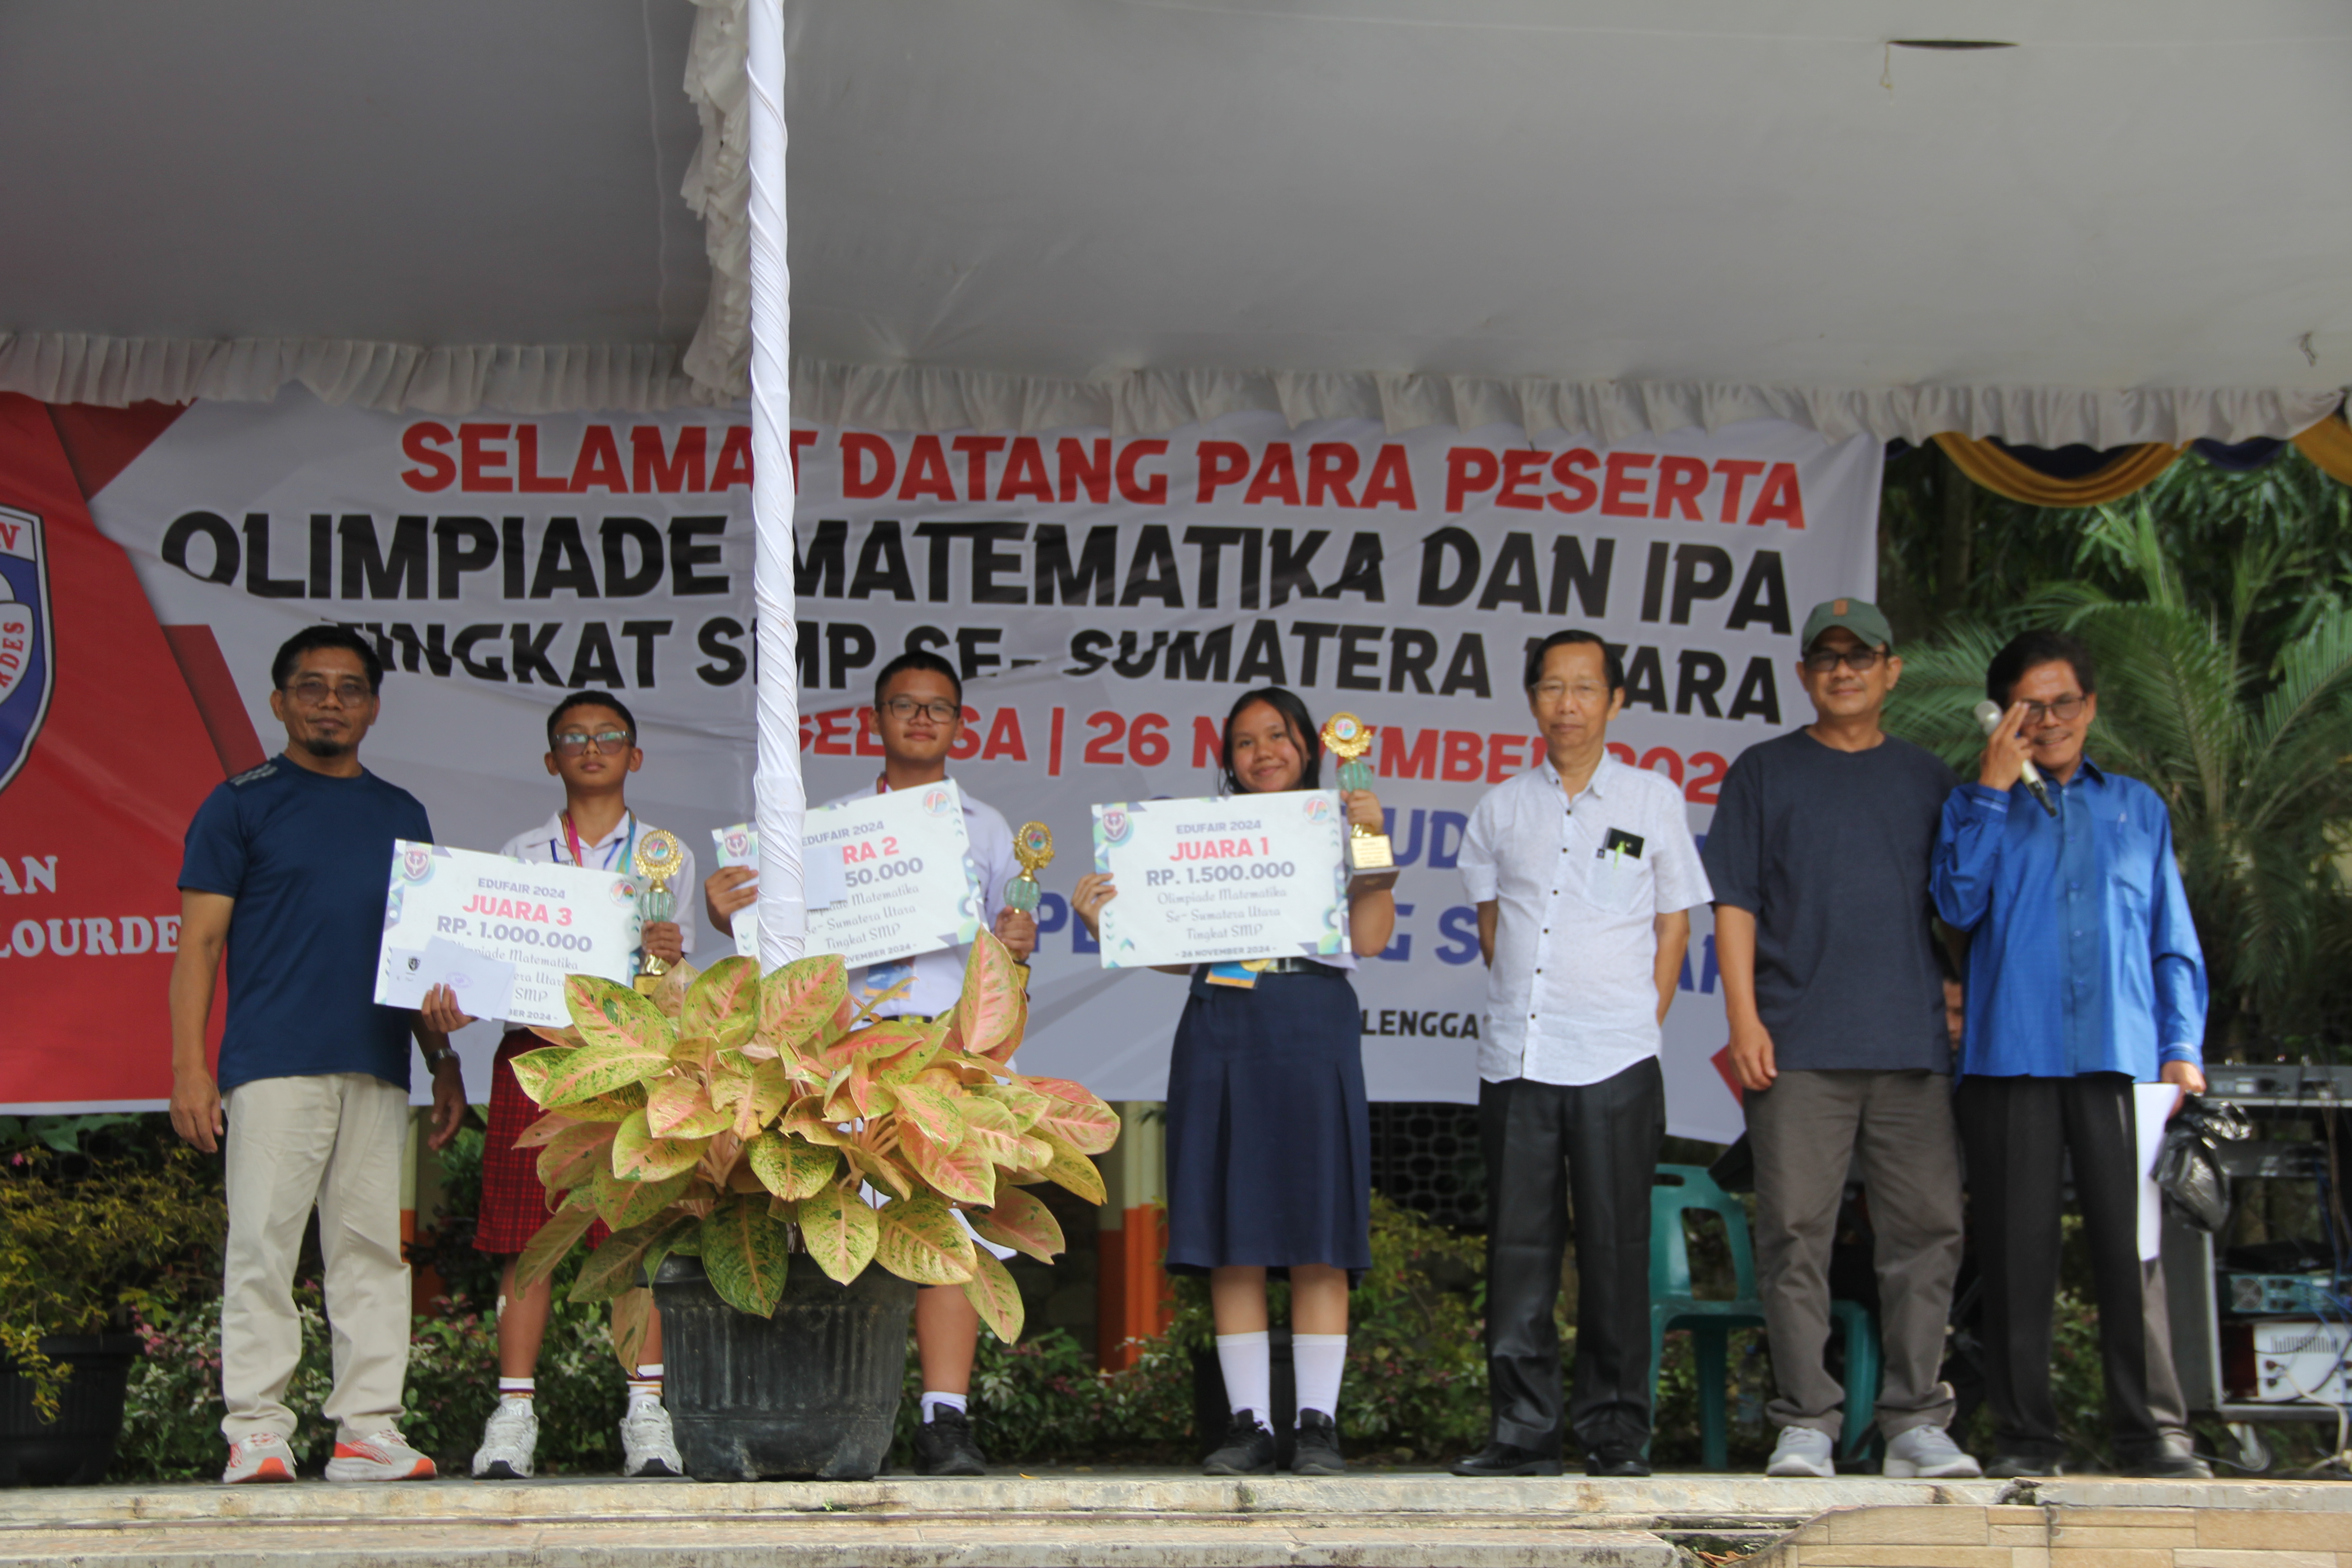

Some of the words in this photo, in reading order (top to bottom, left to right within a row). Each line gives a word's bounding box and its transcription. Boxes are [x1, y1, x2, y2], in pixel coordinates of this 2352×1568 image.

[839, 431, 1169, 505] DATANG
[1196, 441, 1417, 511] PARA
[1445, 446, 1805, 529] PESERTA
[162, 511, 729, 600] OLIMPIADE
[793, 520, 1385, 610] MATEMATIKA
[1417, 526, 1616, 618] DAN
[1640, 541, 1792, 636] IPA
[320, 617, 673, 689] INGKAT
[1063, 619, 1492, 699] SUMATERA
[1524, 637, 1781, 725] ARA
[799, 706, 1028, 761] ELSA
[1084, 710, 1170, 767] 26
[853, 821, 884, 835] 2024
[1176, 822, 1226, 834] EDUFAIR
[1230, 819, 1262, 831] 2024
[1169, 838, 1254, 862] JUARA
[1260, 837, 1269, 855] 1
[845, 857, 924, 887] 50.000
[1146, 869, 1181, 886] RP.
[1187, 861, 1295, 883] 1.500.000
[478, 877, 530, 894] EDUFAIR
[533, 886, 566, 899] 2024
[852, 884, 919, 906] Matematika
[1157, 890, 1215, 906] Olimpiade
[1219, 886, 1287, 901] Matematika
[462, 894, 549, 924] JUARA
[556, 907, 573, 926] 3
[827, 913, 881, 931] Sumatera
[883, 906, 916, 918] Utara
[0, 915, 181, 958] OURDE
[437, 916, 471, 936] RP.
[480, 921, 593, 952] 1.000.000
[826, 933, 866, 949] Tingkat
[869, 923, 901, 941] SMP
[1231, 923, 1263, 938] SMP
[510, 949, 578, 970] Matematika
[845, 949, 886, 963] OVEMBER
[887, 943, 911, 954] 2024
[1195, 946, 1245, 957] NOVEMBER
[1247, 945, 1270, 953] 2024
[515, 987, 548, 1002] SMP
[527, 1011, 551, 1020] 2024
